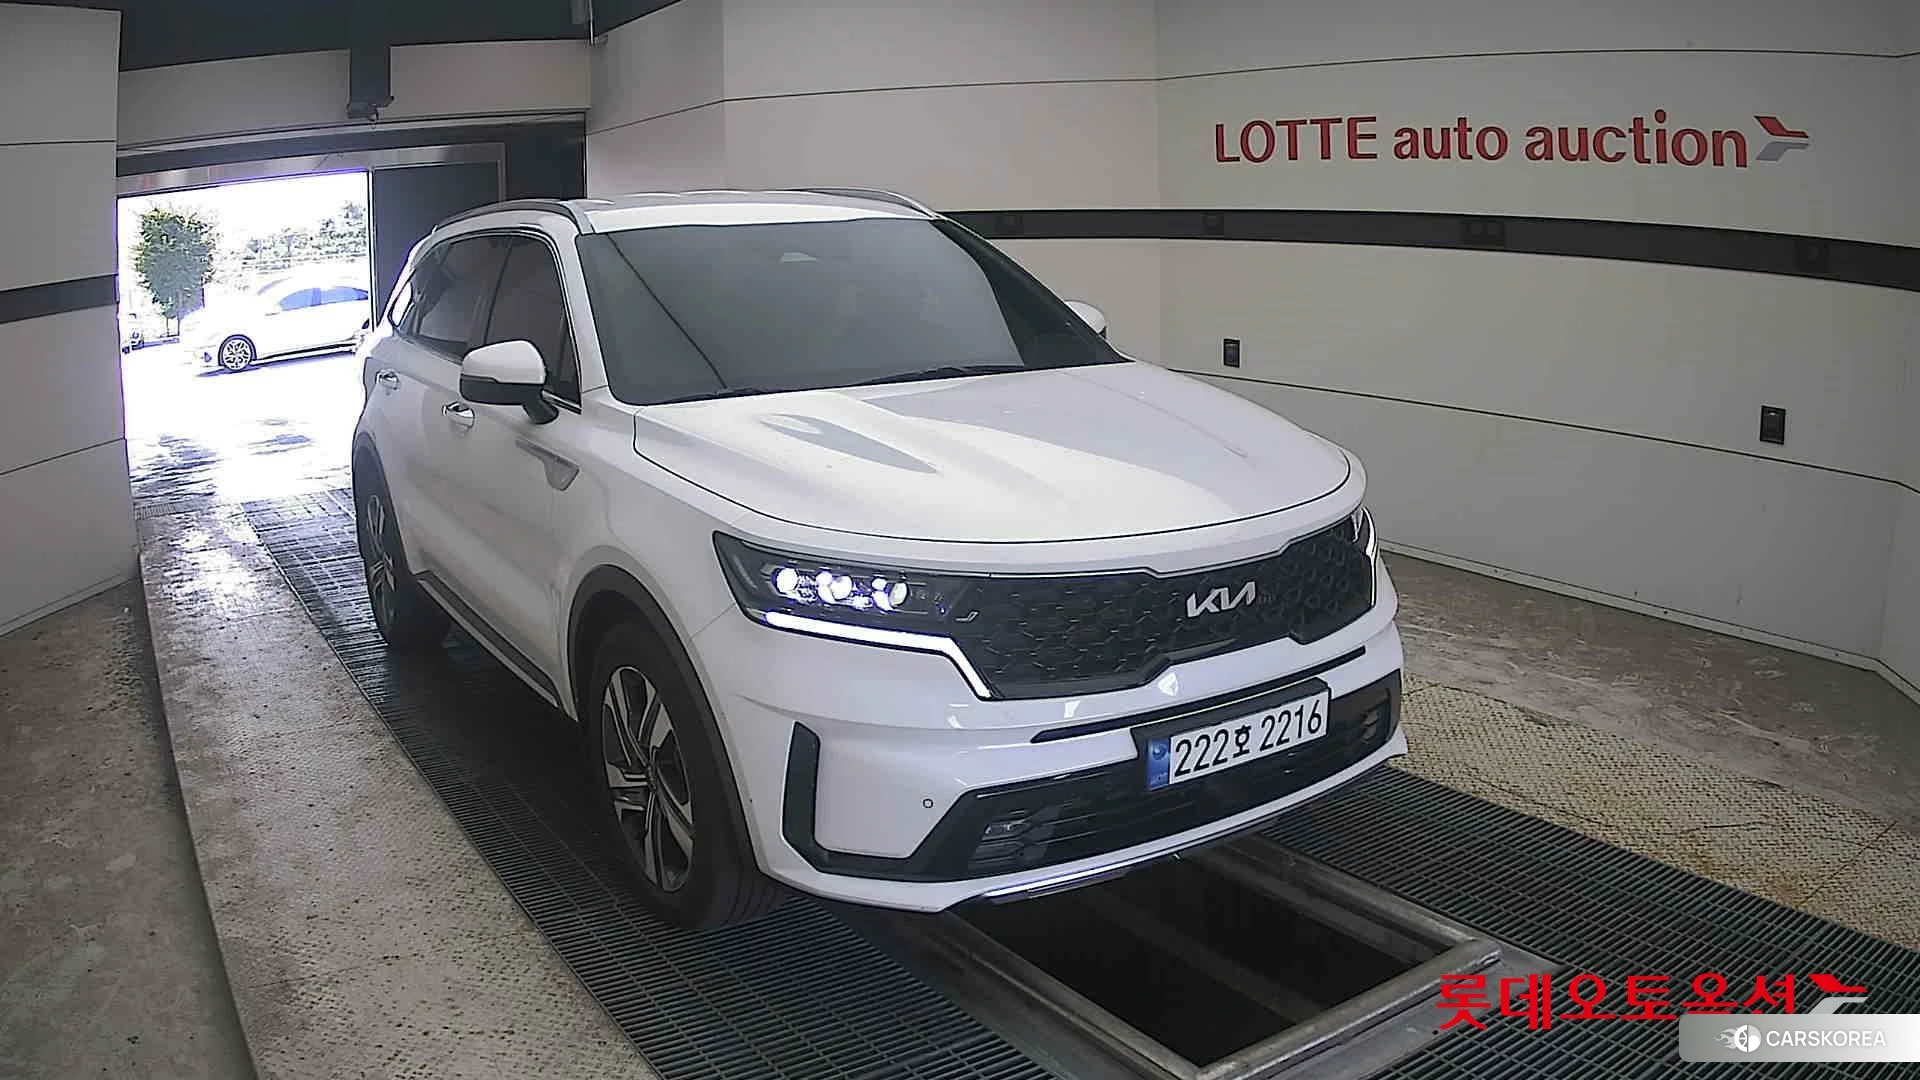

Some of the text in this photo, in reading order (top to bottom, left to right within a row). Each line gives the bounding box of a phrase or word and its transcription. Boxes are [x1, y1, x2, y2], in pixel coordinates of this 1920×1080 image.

[1214, 110, 1748, 169] LOTTE auto auction
[1186, 581, 1256, 618] KIA
[1173, 699, 1323, 777] 222호 2216
